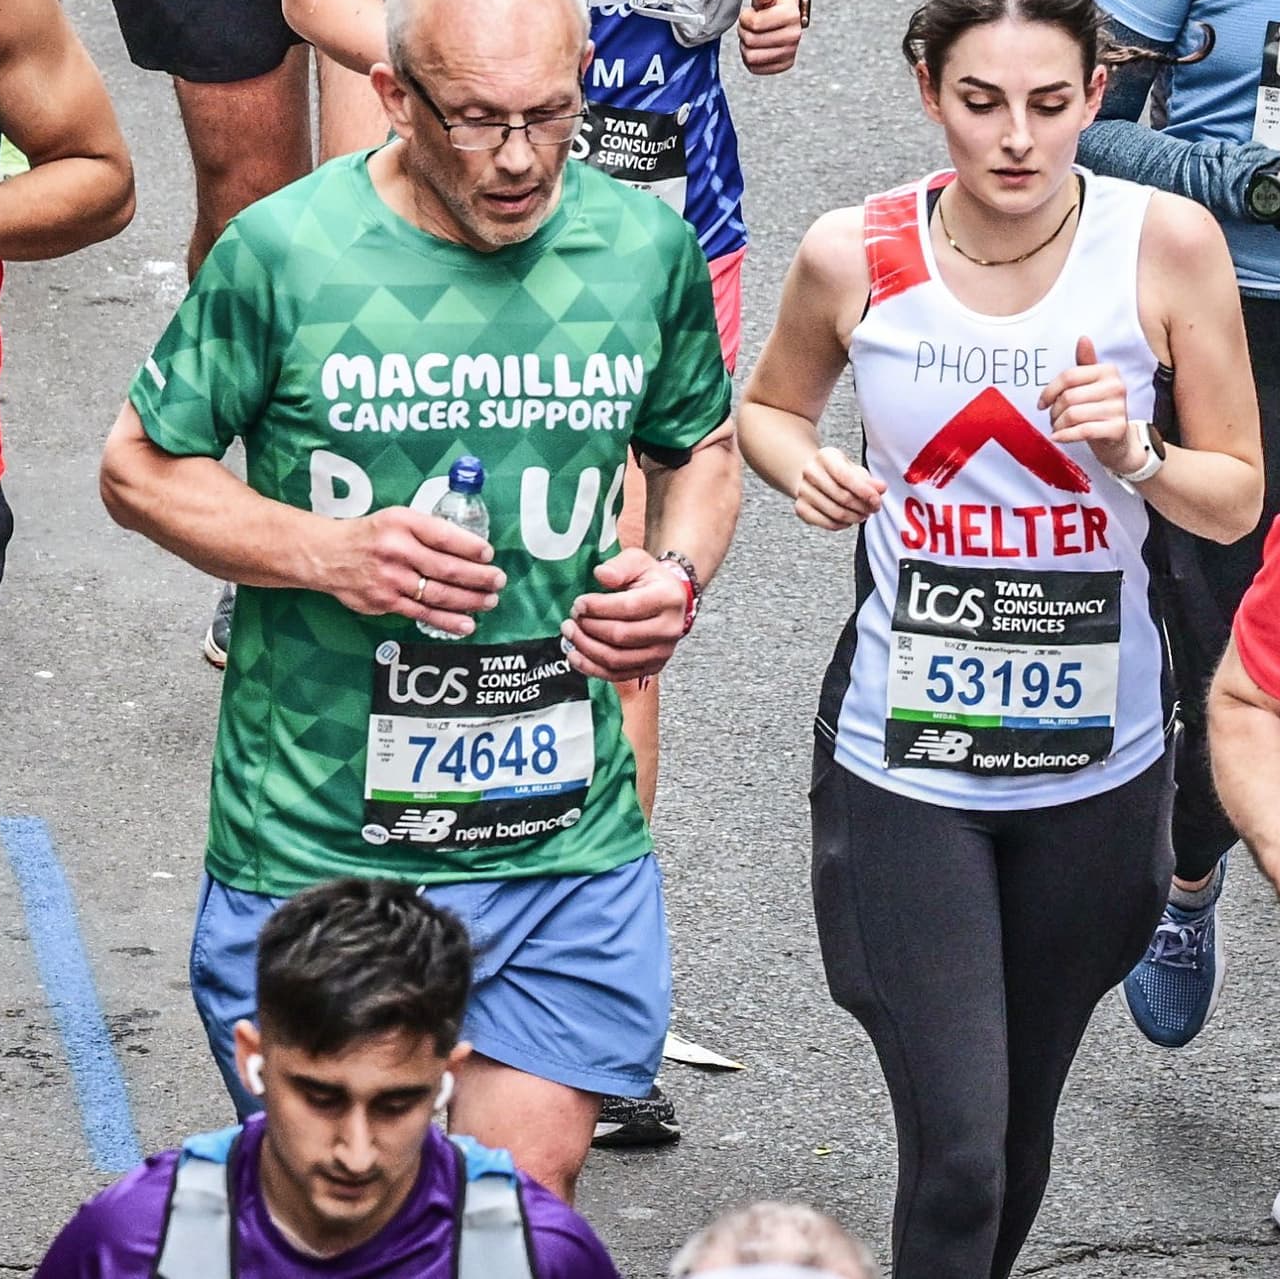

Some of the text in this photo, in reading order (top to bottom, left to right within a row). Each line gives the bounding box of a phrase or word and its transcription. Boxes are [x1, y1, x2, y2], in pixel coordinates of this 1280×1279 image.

[604, 117, 650, 137] TATA
[597, 150, 659, 171] SERVICES
[321, 352, 644, 400] MACMILLAN
[914, 340, 1050, 387] PHOEBE
[328, 399, 633, 432] CANCER SUPPORT
[900, 496, 1110, 558] SHELTER
[907, 571, 985, 628] tcs
[994, 580, 1044, 597] TATA
[993, 598, 1107, 616] CONSULTANCY
[991, 615, 1066, 633] SERVICES
[477, 659, 572, 689] CONSULTANCY
[480, 655, 527, 671] TATA
[388, 658, 469, 705] tcs
[475, 683, 541, 705] SERVICES
[925, 655, 1083, 710] 53195
[408, 723, 559, 784] 74648
[972, 751, 1091, 769] new balance
[455, 826, 492, 841] new
